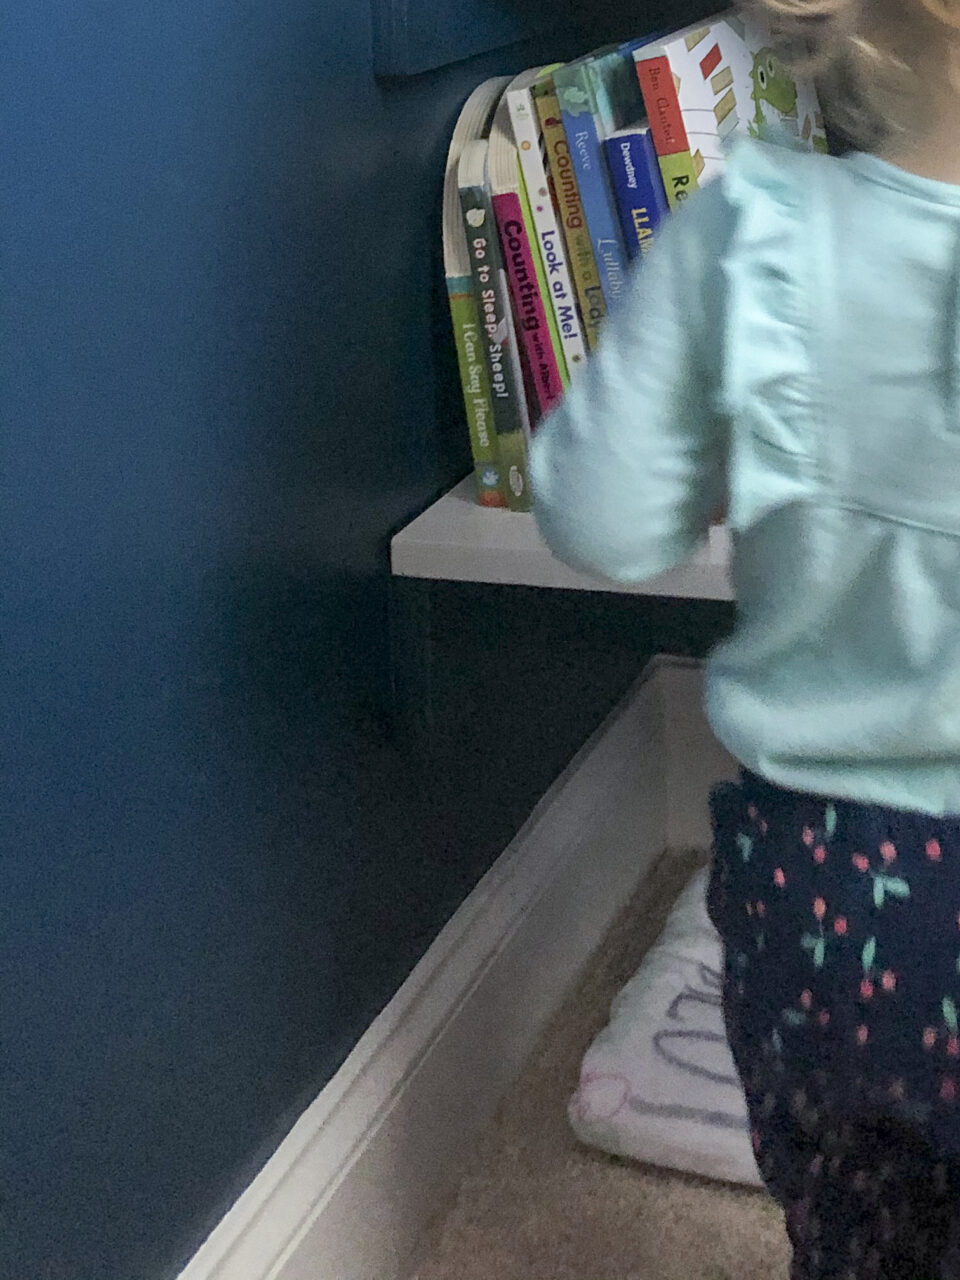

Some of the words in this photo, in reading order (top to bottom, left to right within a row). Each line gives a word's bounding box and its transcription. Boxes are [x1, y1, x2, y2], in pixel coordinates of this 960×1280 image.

[576, 131, 590, 170] Reeve
[620, 143, 637, 189] Dewdney
[554, 141, 582, 229] Counting
[673, 176, 689, 201] Re
[542, 232, 559, 274] Look
[598, 239, 625, 298] Lullaby
[504, 221, 540, 332] Counting
[534, 333, 544, 359] with
[539, 364, 555, 399] Albert
[553, 281, 565, 301] at
[473, 239, 485, 258] Go
[480, 266, 489, 282] to
[489, 344, 508, 398] Sheep!
[558, 305, 577, 340] Me!
[464, 331, 476, 362] Can
[466, 365, 482, 394] Say
[474, 398, 489, 447] Please
